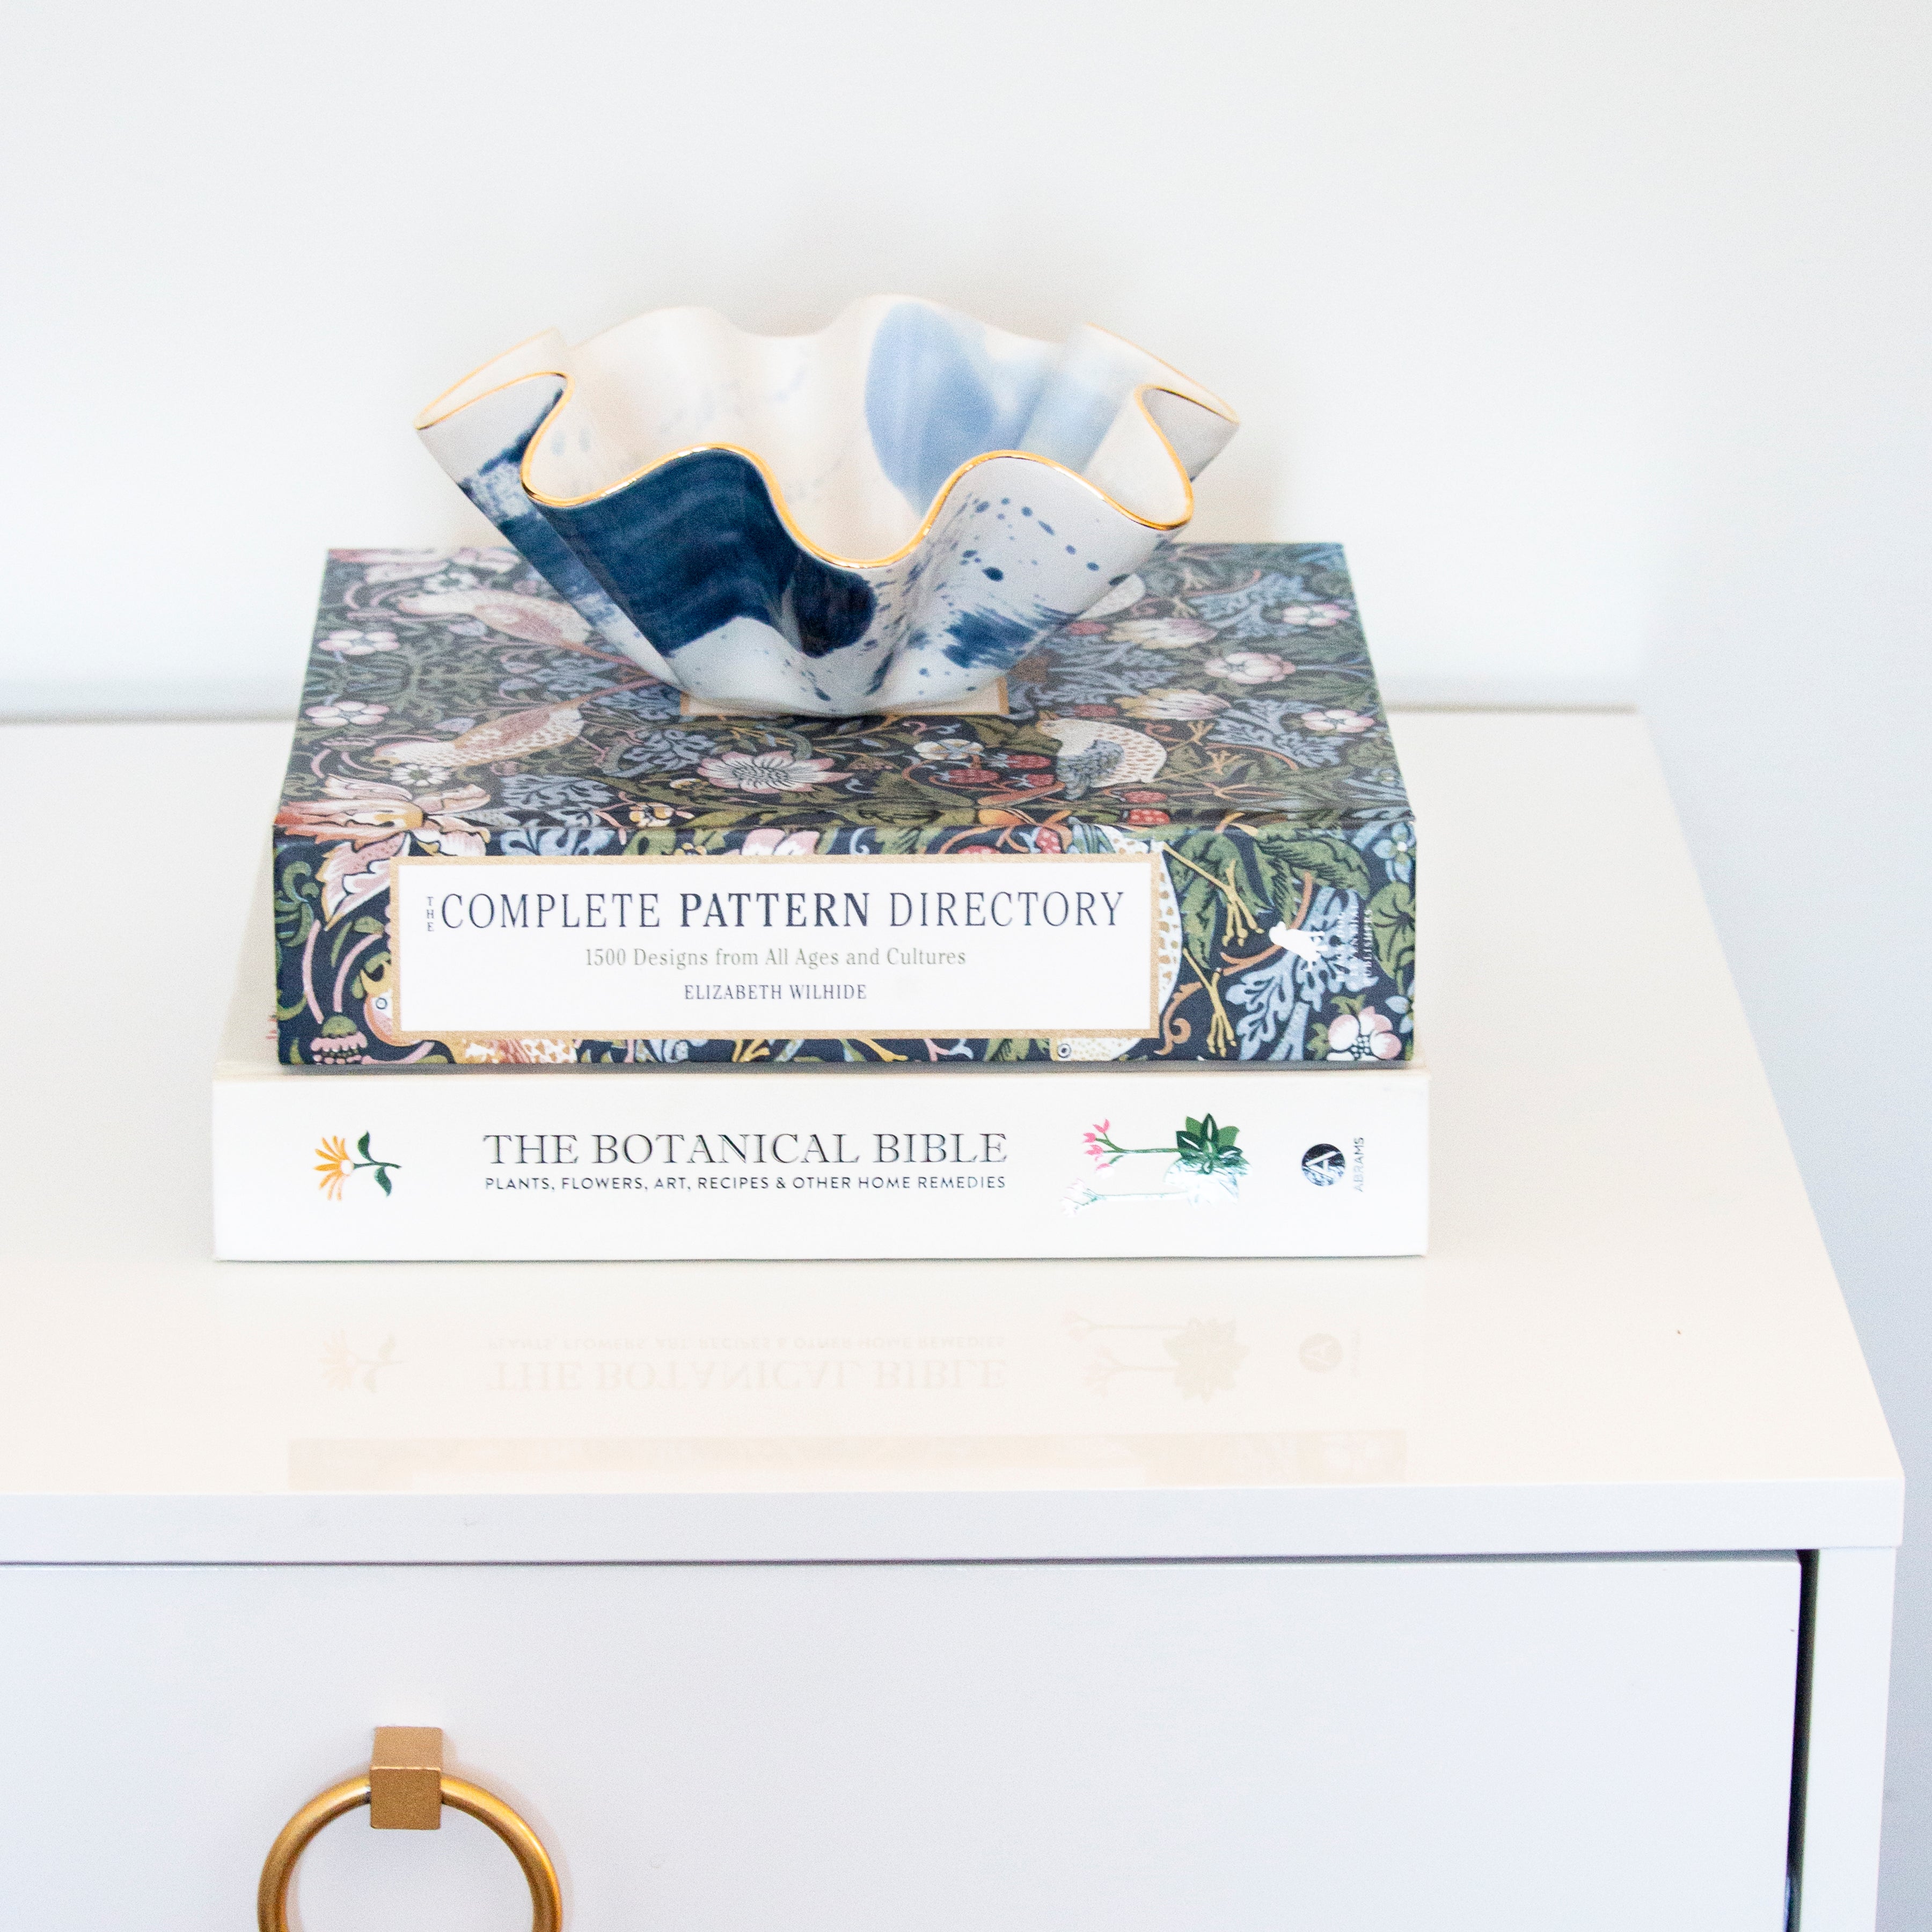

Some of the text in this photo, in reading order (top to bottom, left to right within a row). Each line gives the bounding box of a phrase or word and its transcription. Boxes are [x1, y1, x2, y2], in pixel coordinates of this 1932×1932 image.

[426, 890, 1124, 932] THE COMPLETE PATTERN DIRECTORY
[586, 947, 966, 970] 1500 Designs from All Ages and Cultures
[684, 984, 867, 1000] ELIZABETH WILHIDE
[482, 1133, 1007, 1165] THE BOTANICAL BIBLE
[1352, 1136, 1365, 1192] ABRAMS
[485, 1175, 1006, 1192] PLANTS, FLOWERS, ART, RECIPES & OTHER HOME REMEDIES
